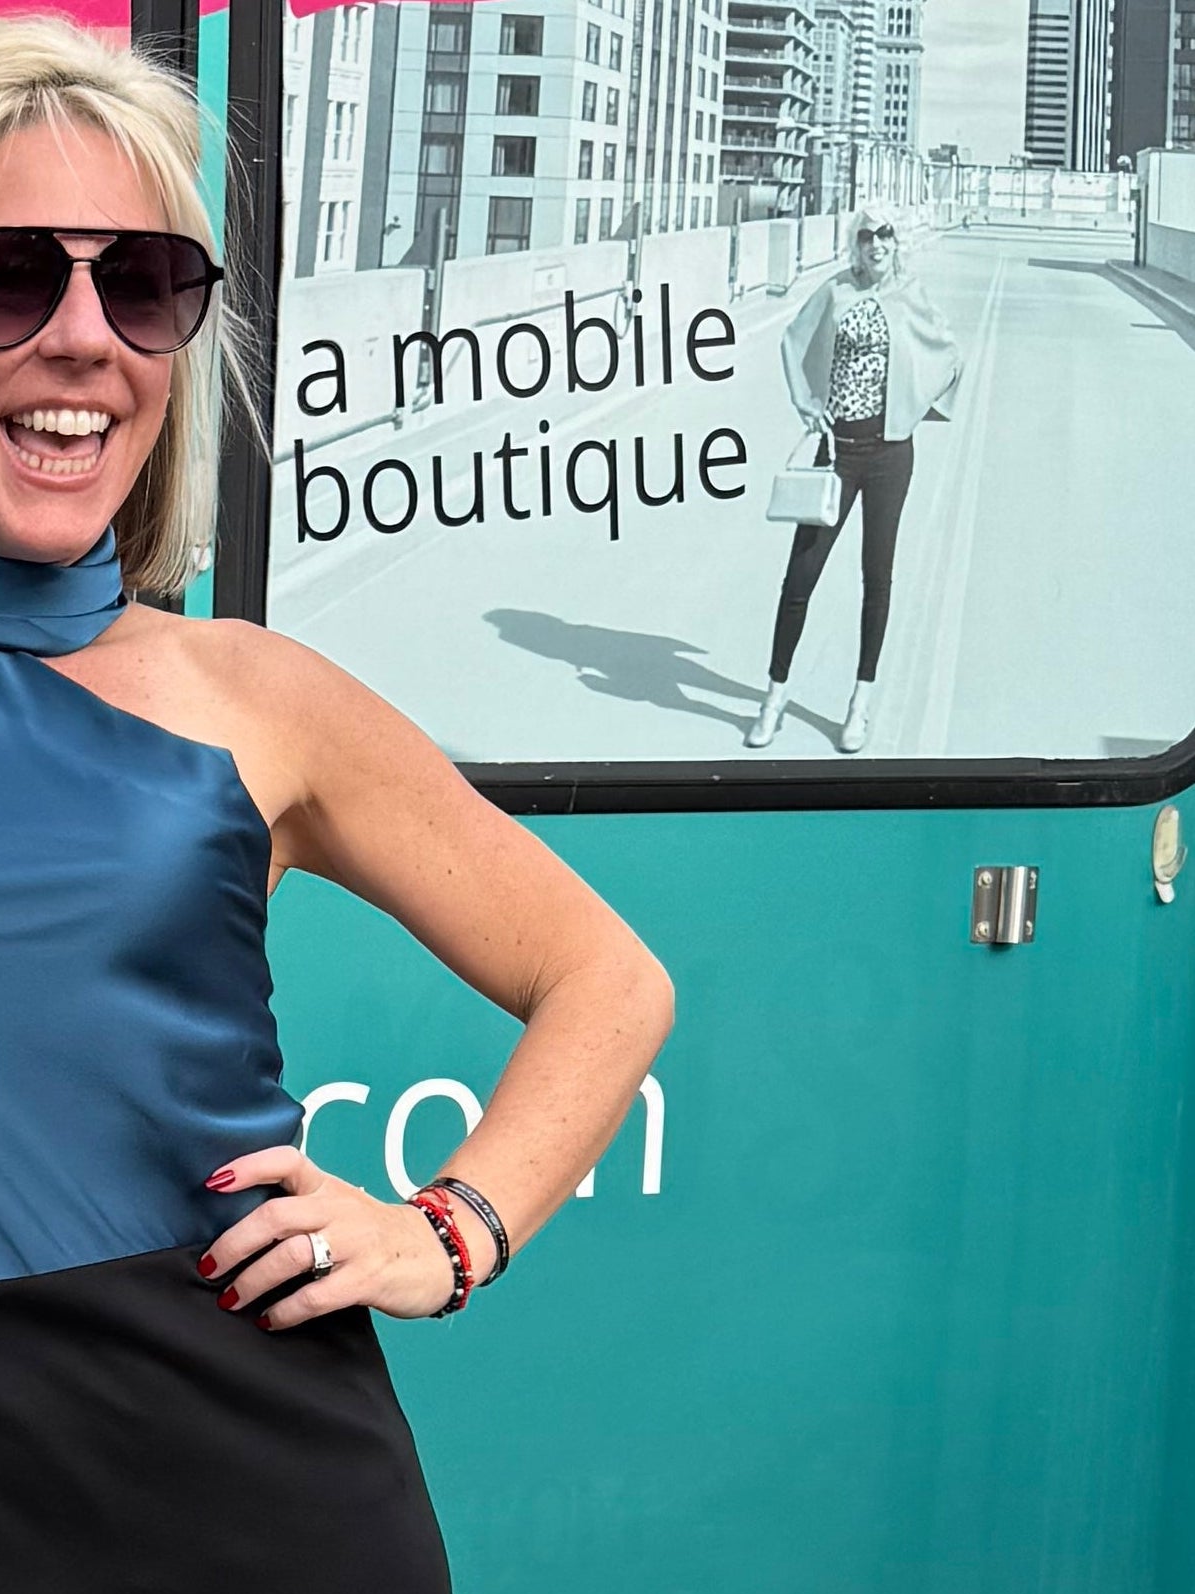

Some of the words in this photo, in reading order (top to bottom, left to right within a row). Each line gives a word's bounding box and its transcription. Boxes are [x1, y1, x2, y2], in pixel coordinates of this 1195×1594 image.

[295, 338, 349, 417] a
[392, 283, 737, 410] mobile
[294, 419, 749, 544] boutique
